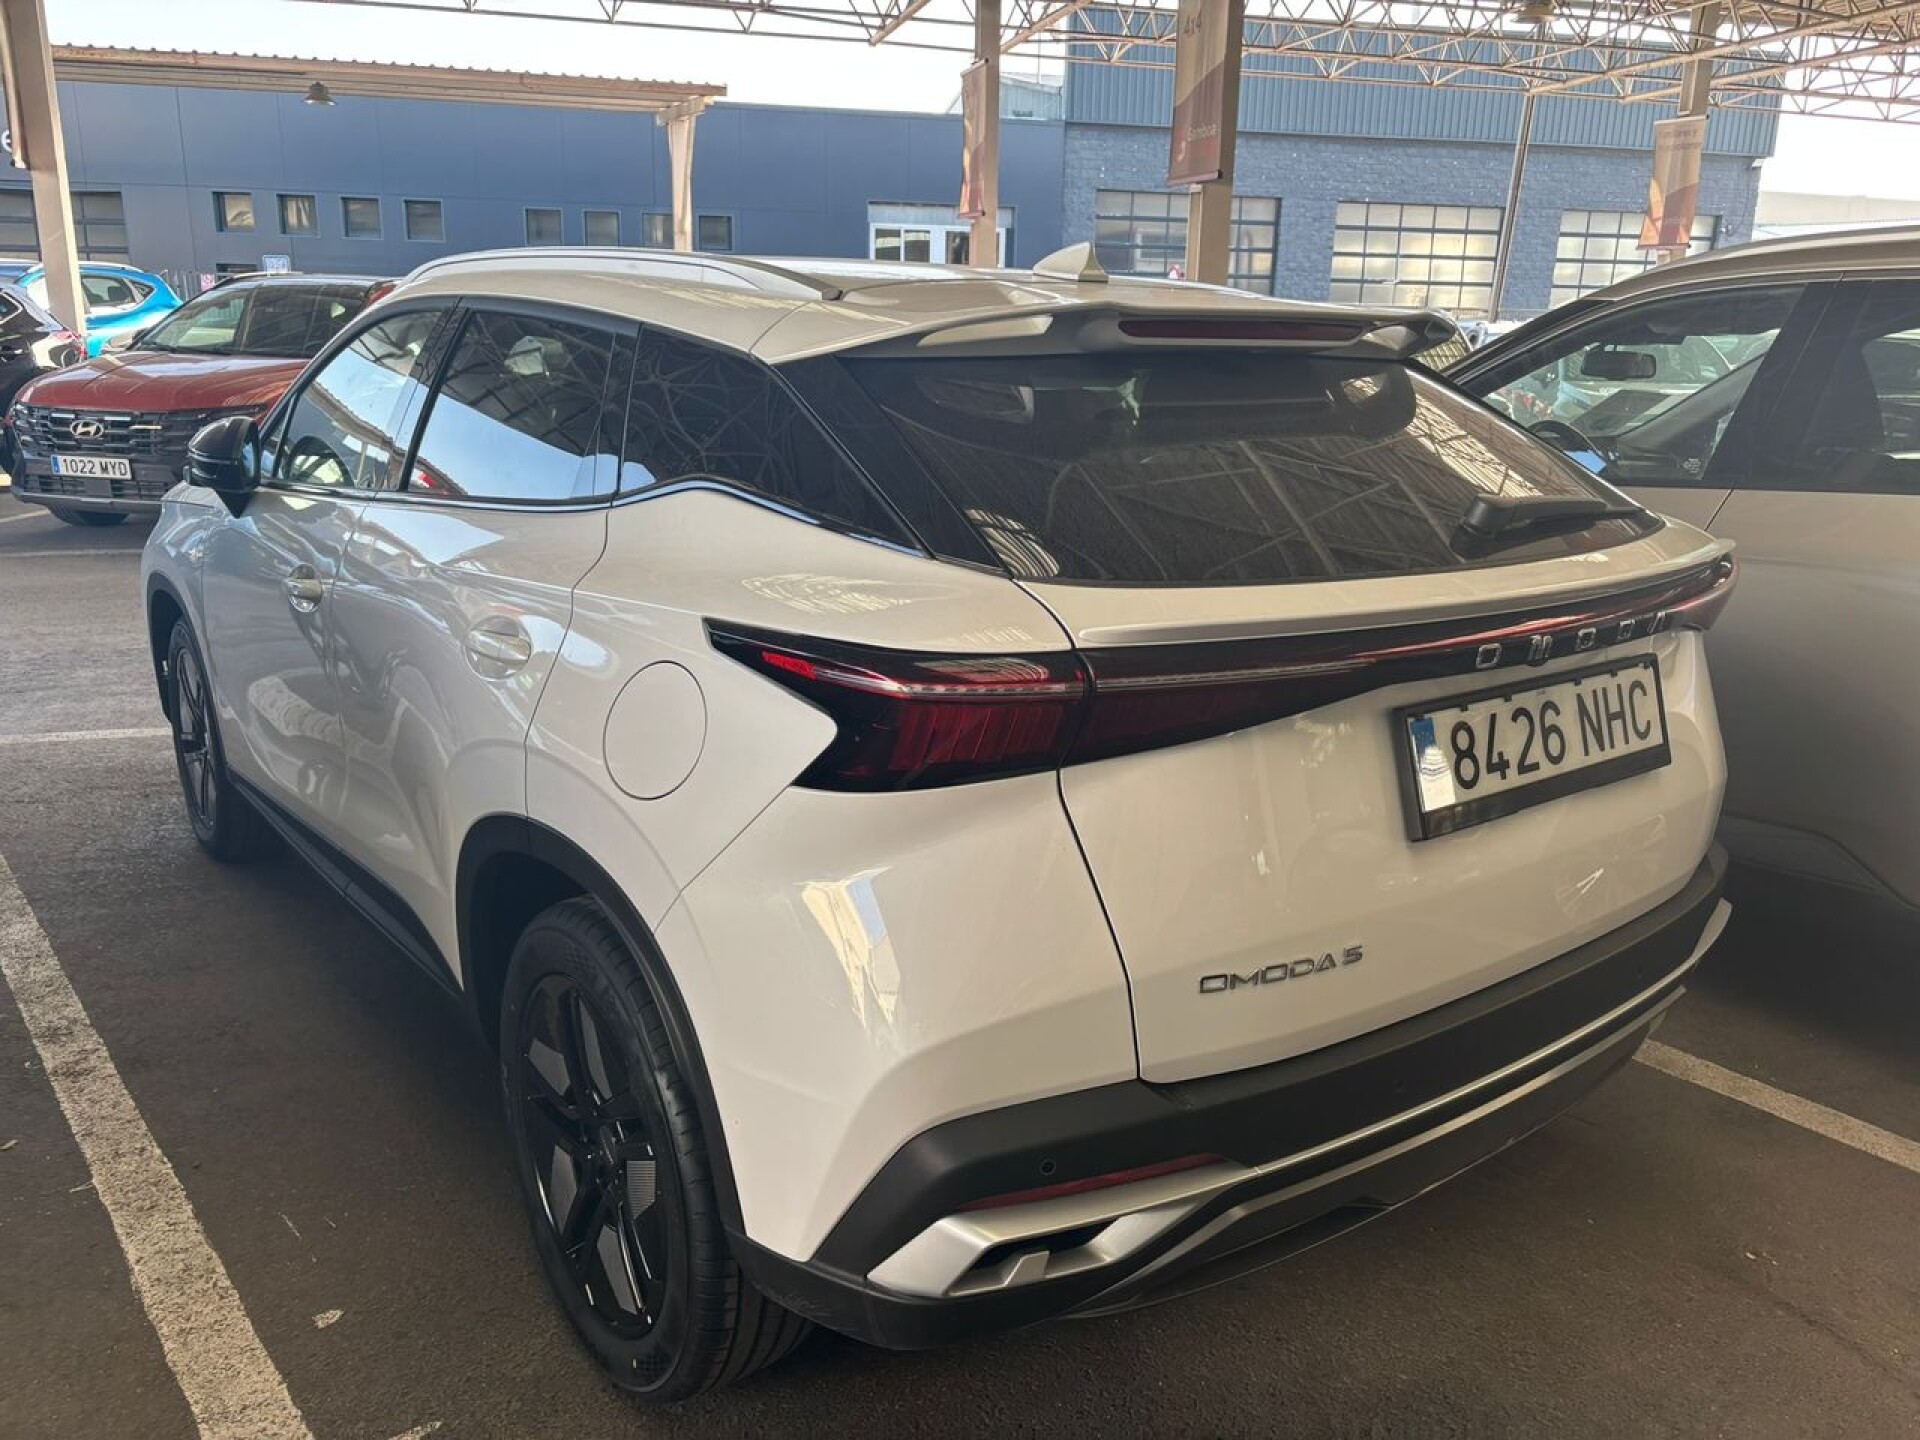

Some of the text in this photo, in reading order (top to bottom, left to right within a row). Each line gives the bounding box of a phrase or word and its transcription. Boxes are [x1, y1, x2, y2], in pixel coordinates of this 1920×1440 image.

[63, 458, 96, 474] 1022
[1451, 680, 1651, 790] 8426 NHC
[1199, 944, 1363, 994] OMODA 5
